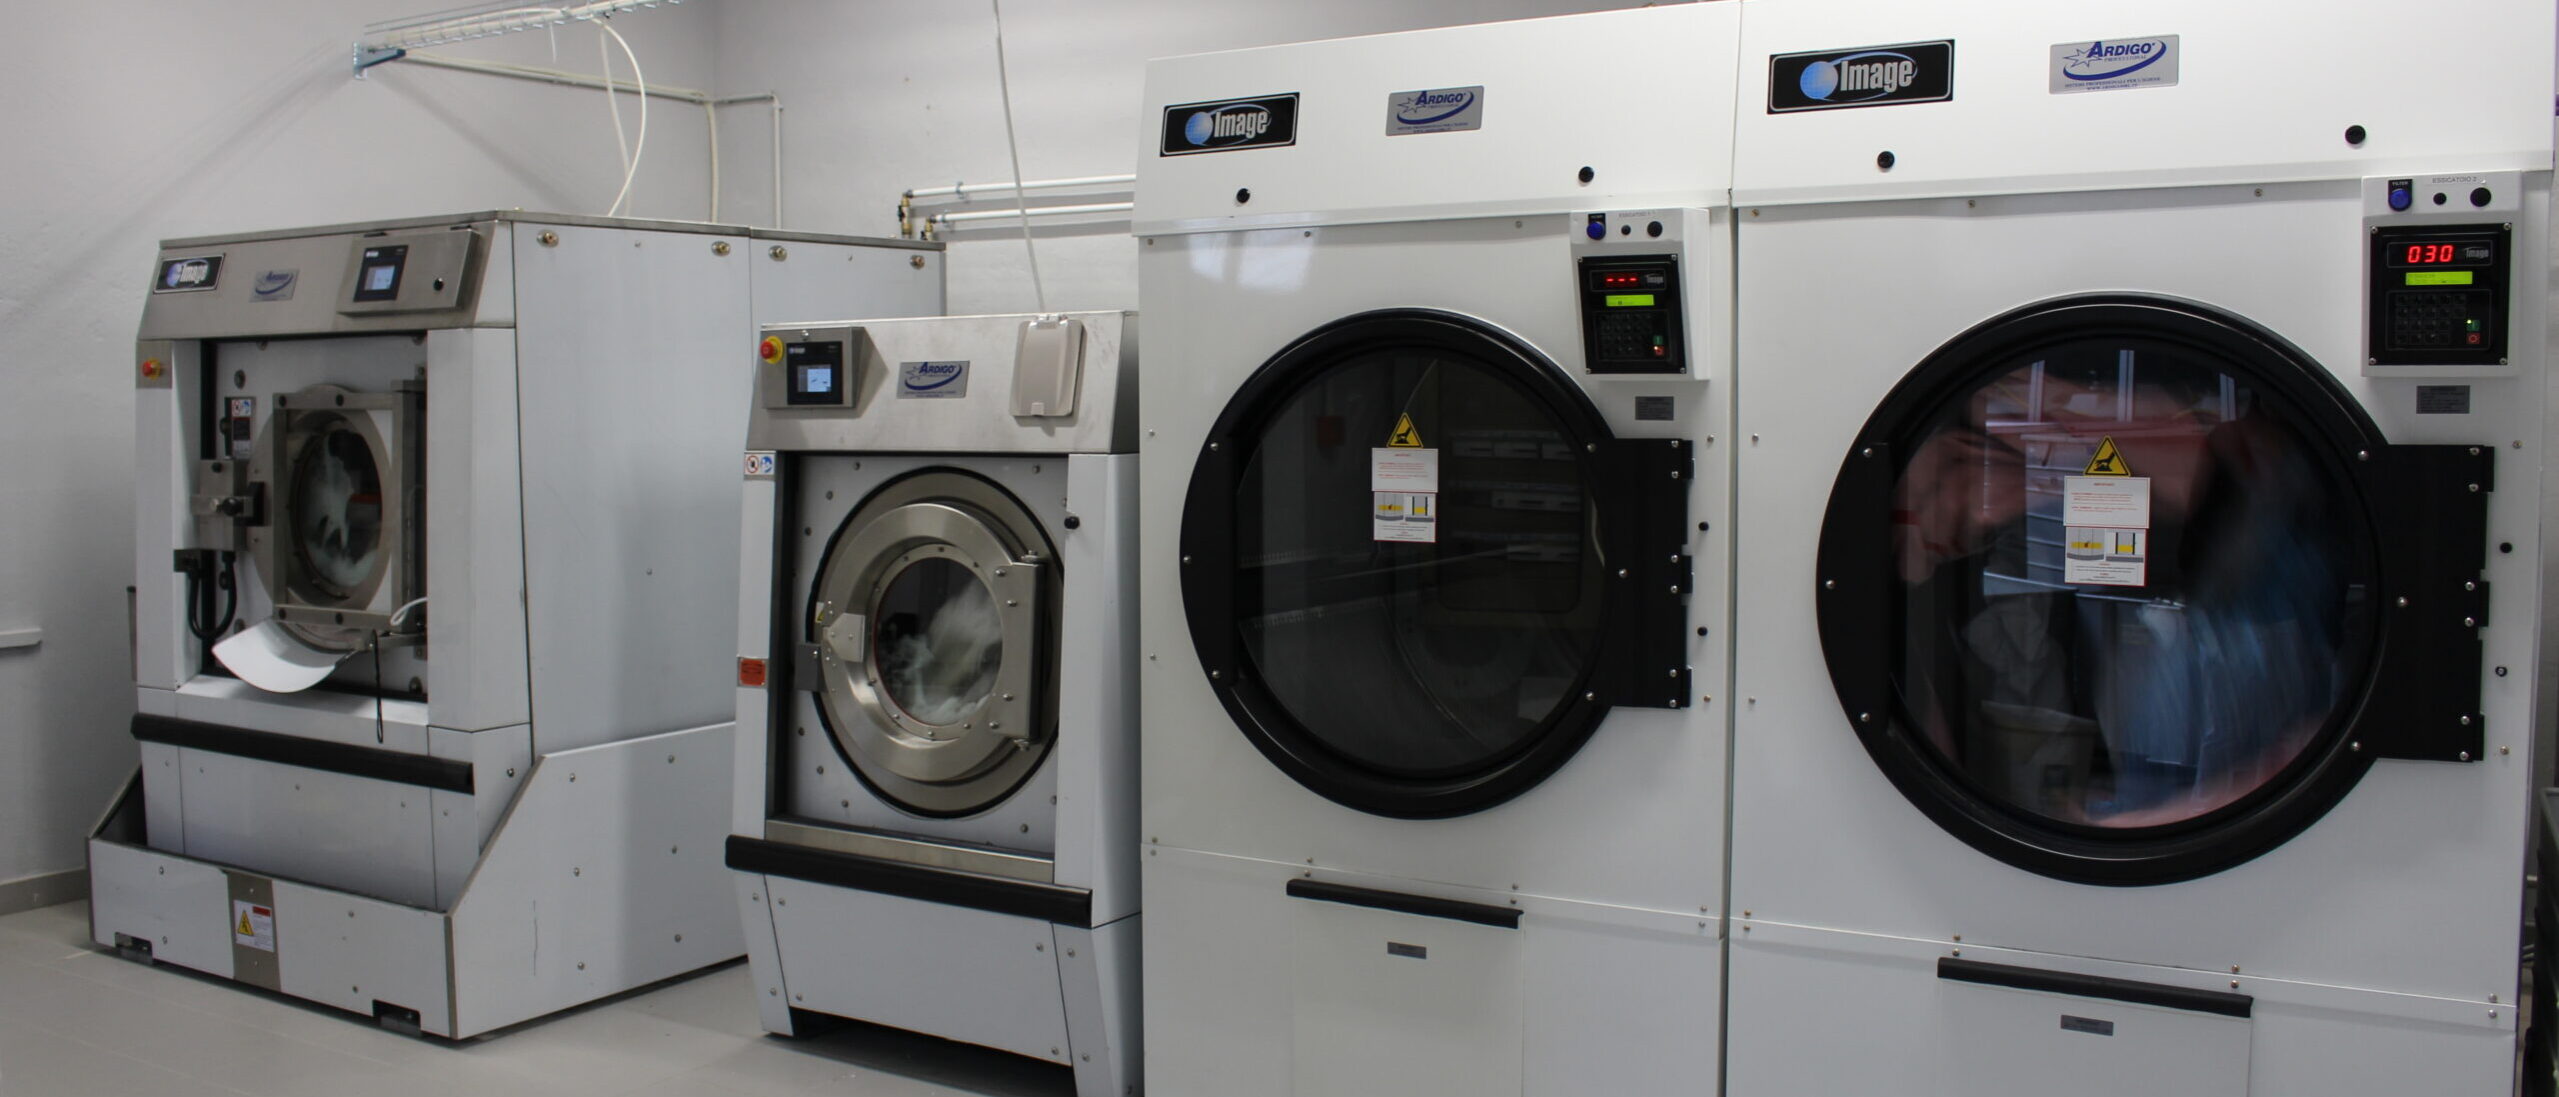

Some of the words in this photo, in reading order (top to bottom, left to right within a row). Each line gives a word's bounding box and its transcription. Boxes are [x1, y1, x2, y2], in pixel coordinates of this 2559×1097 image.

[1840, 60, 1914, 93] Image
[1214, 111, 1268, 139] Image
[2407, 244, 2454, 263] 030
